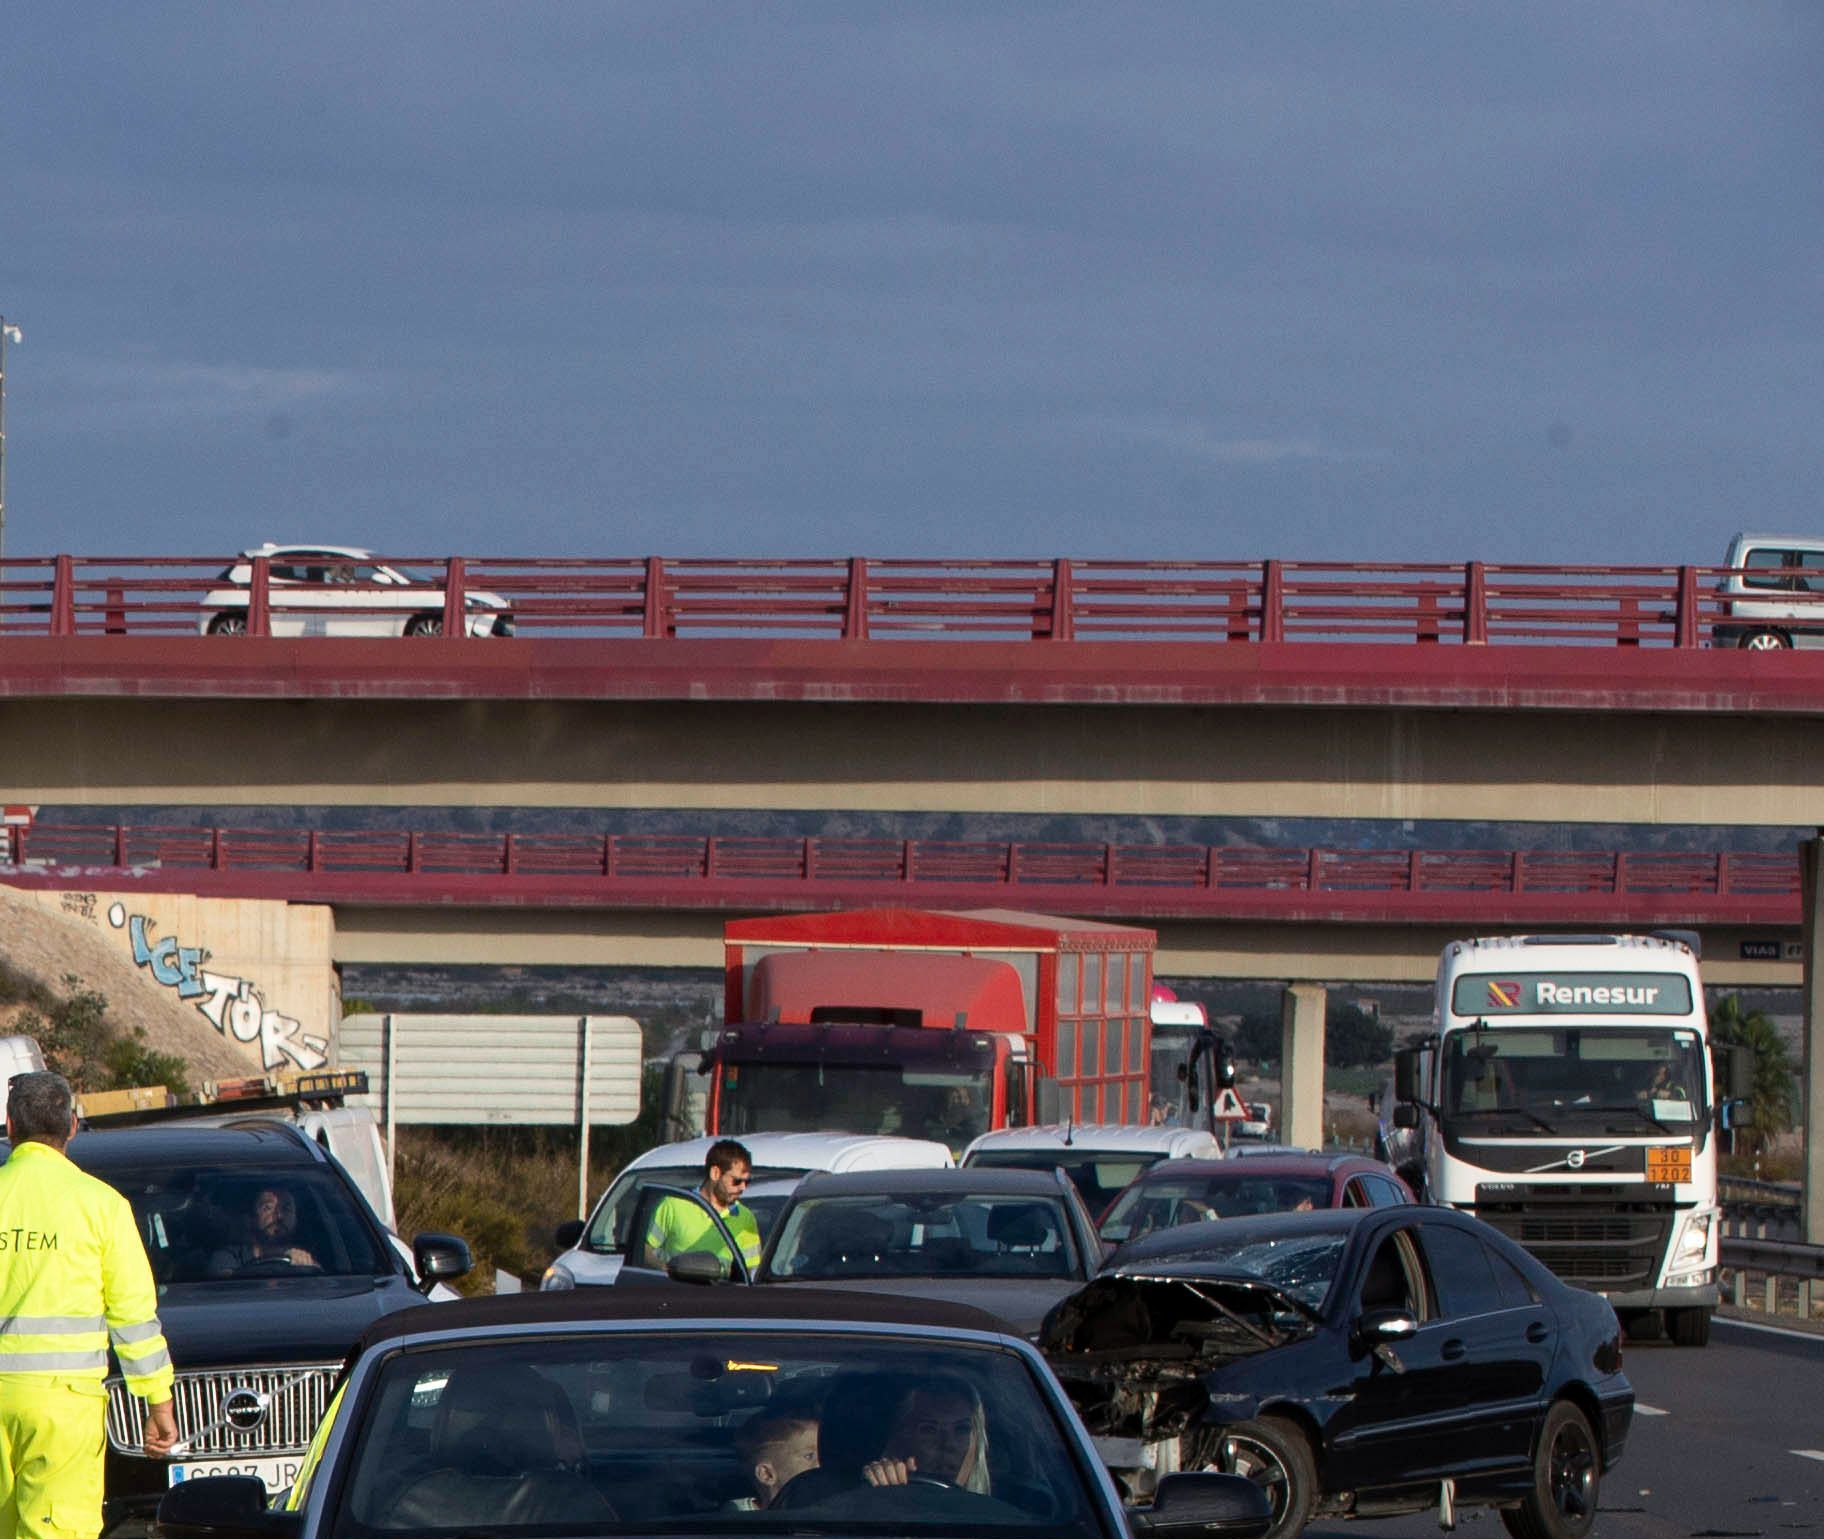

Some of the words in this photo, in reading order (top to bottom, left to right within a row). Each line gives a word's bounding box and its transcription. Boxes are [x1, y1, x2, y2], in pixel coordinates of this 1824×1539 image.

[1536, 982, 1658, 1005] Renesur
[1660, 1150, 1679, 1163] 30
[1651, 1167, 1690, 1181] 1202
[267, 1463, 299, 1488] JR
